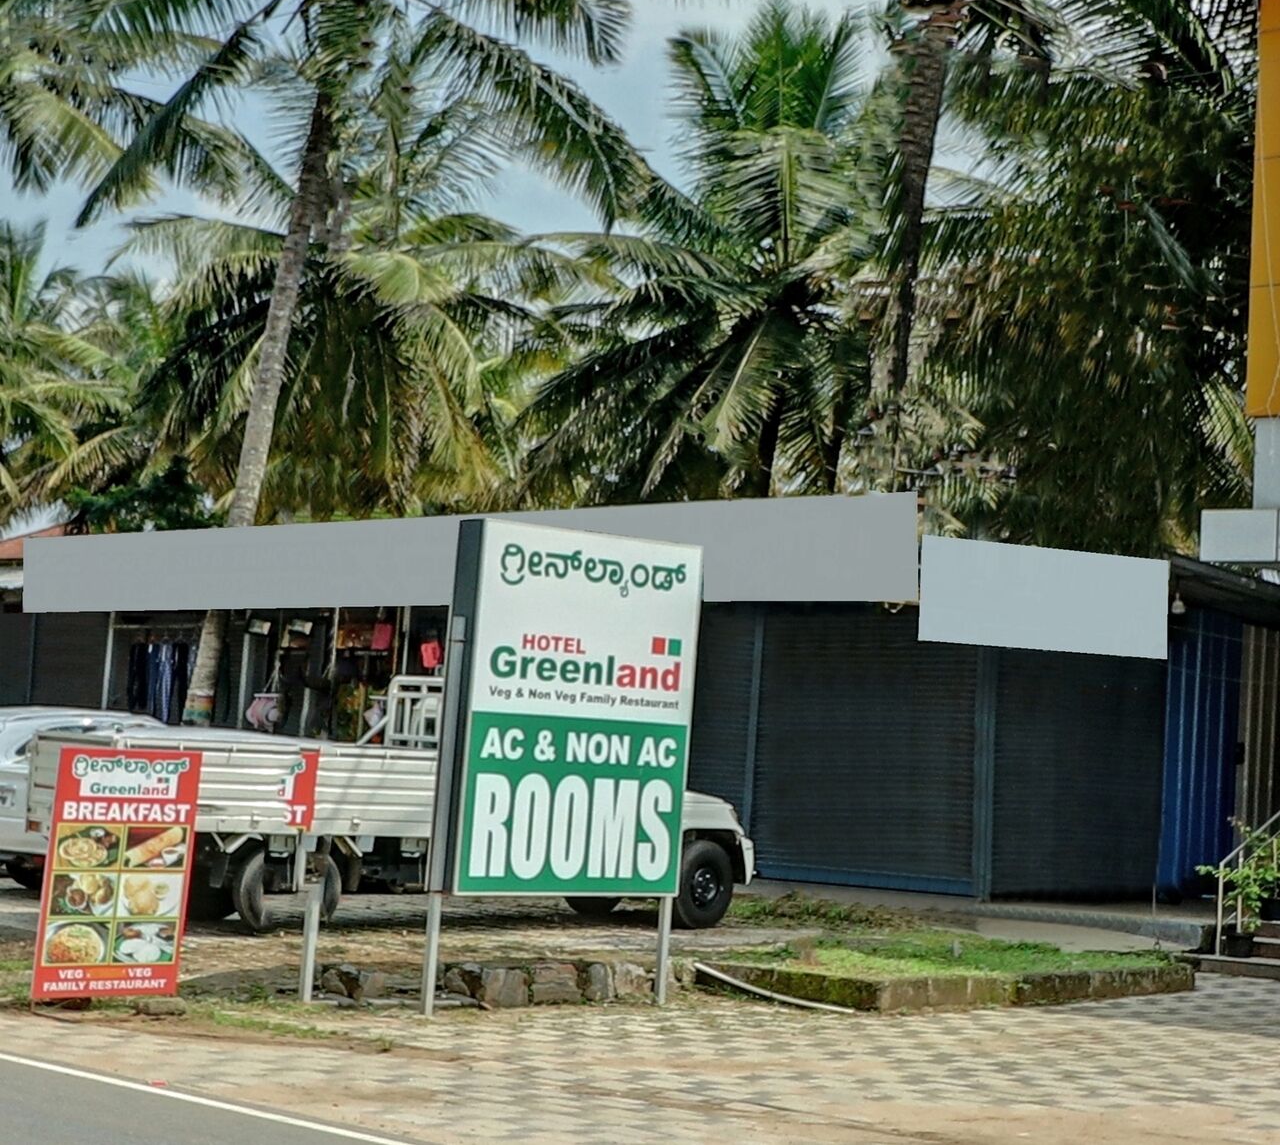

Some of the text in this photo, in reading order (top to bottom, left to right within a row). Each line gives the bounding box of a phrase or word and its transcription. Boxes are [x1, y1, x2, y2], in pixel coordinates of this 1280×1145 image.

[522, 634, 586, 655] HOTEL
[490, 645, 681, 692] Greenland
[489, 685, 679, 710] Veg & Non Veg Family Restaurant
[480, 727, 678, 768] AC & NON AC
[90, 782, 169, 796] Greenland
[62, 801, 191, 822] BREAKFAST
[468, 772, 673, 881] ROOMS
[58, 967, 152, 979] VEG VEG
[43, 978, 167, 992] FAMILY RESTAURANT
